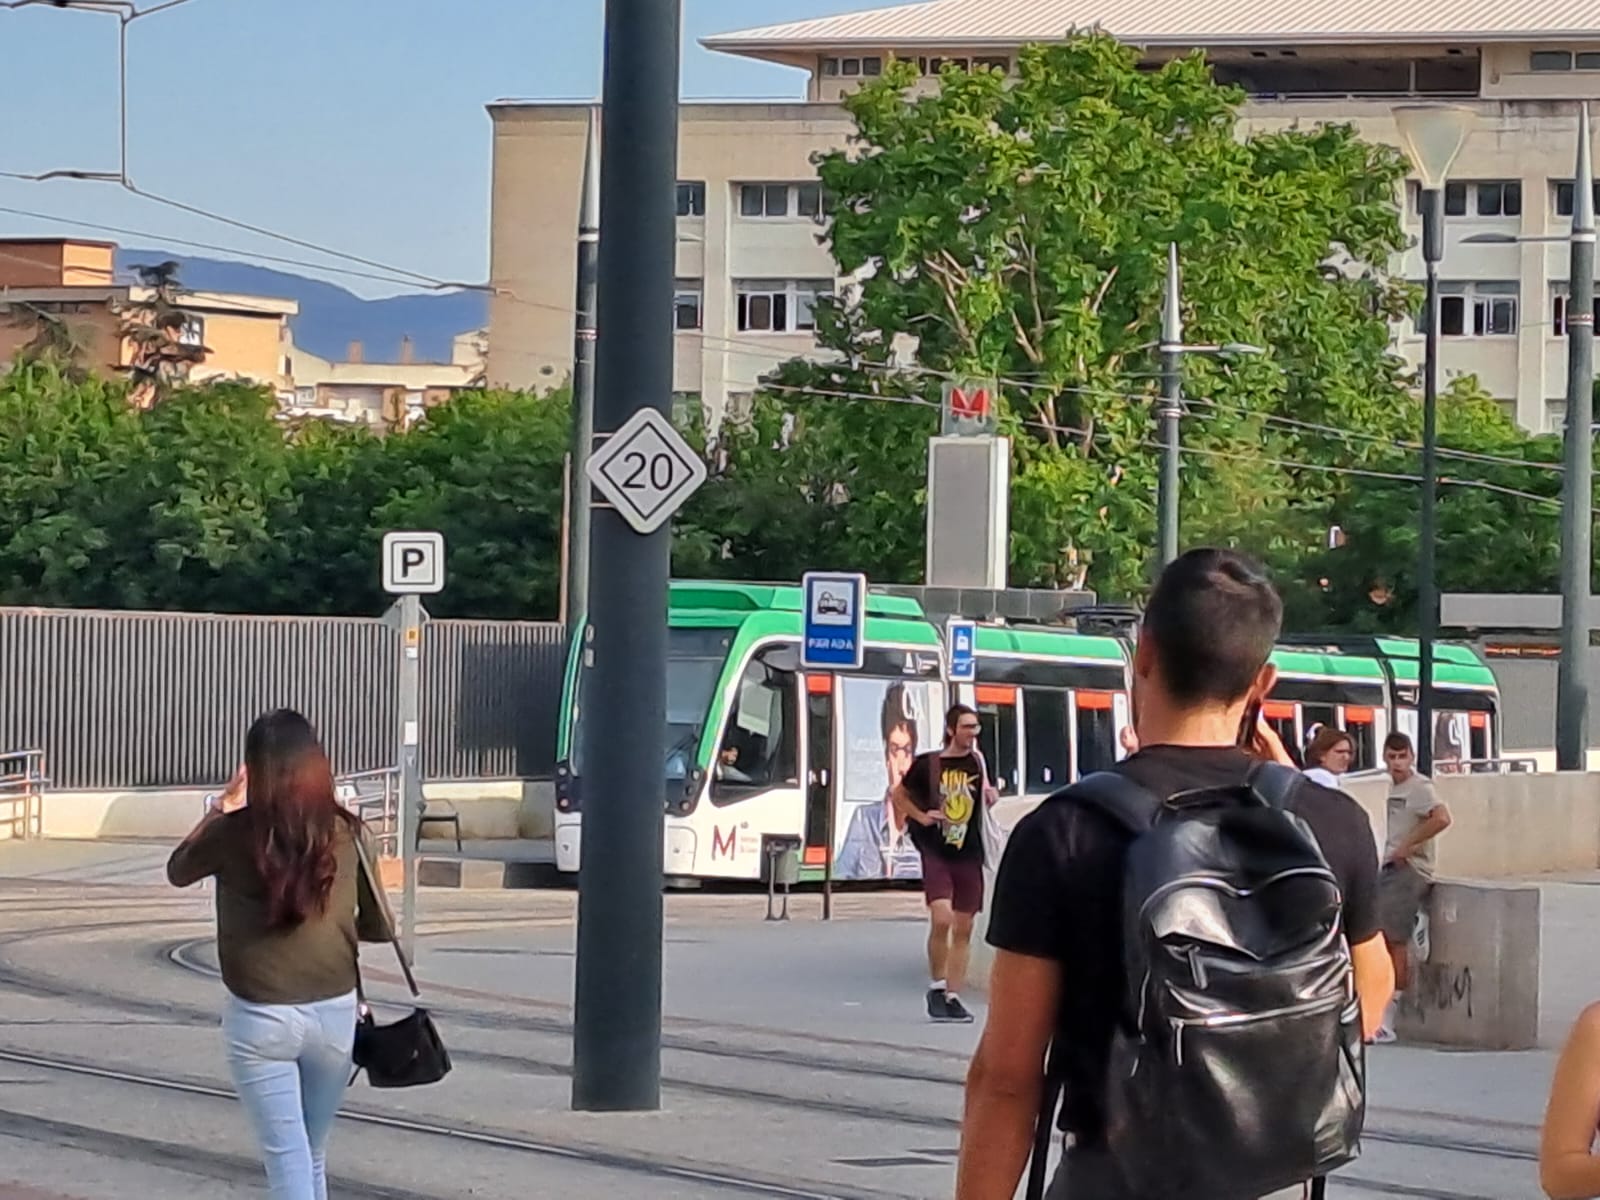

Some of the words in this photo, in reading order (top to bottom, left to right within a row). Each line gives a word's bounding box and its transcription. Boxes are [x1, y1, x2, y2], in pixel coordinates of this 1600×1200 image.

[622, 452, 673, 491] 20
[402, 548, 424, 578] P
[808, 638, 854, 650] PARADA
[711, 824, 737, 861] M
